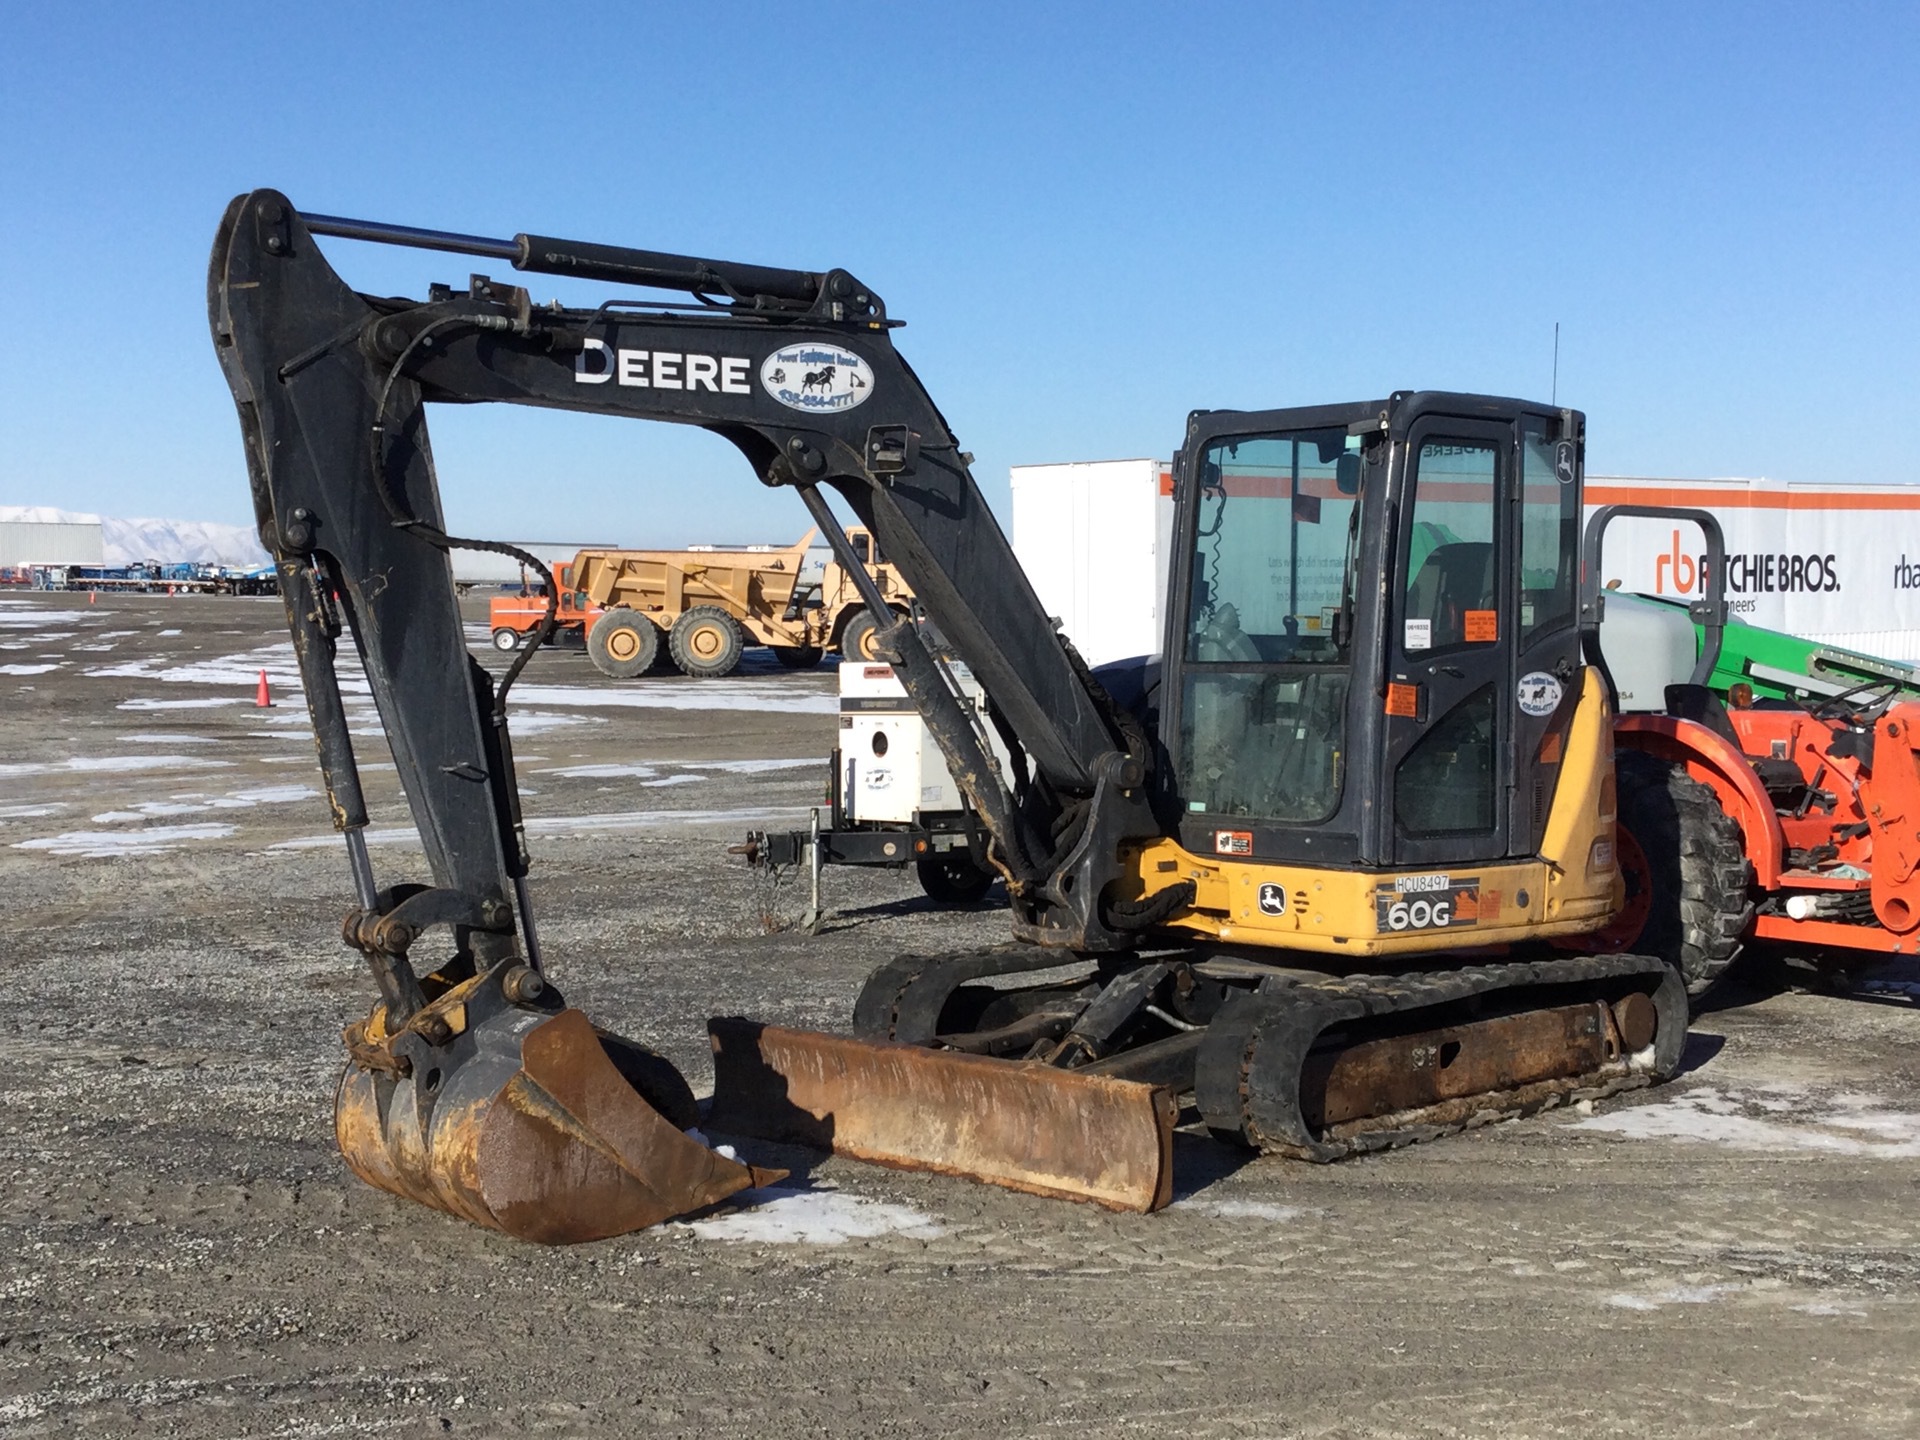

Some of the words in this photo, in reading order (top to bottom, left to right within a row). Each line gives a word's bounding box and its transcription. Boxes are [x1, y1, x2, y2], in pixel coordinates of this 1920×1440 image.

[575, 338, 751, 394] DEERE
[776, 353, 799, 363] Power
[836, 354, 859, 367] Rental
[1656, 529, 1695, 594] rb
[1698, 554, 1774, 593] RTCHIE
[1779, 554, 1841, 593] BROS.
[1396, 875, 1449, 893] HCU8497
[1388, 899, 1450, 931] 60G
